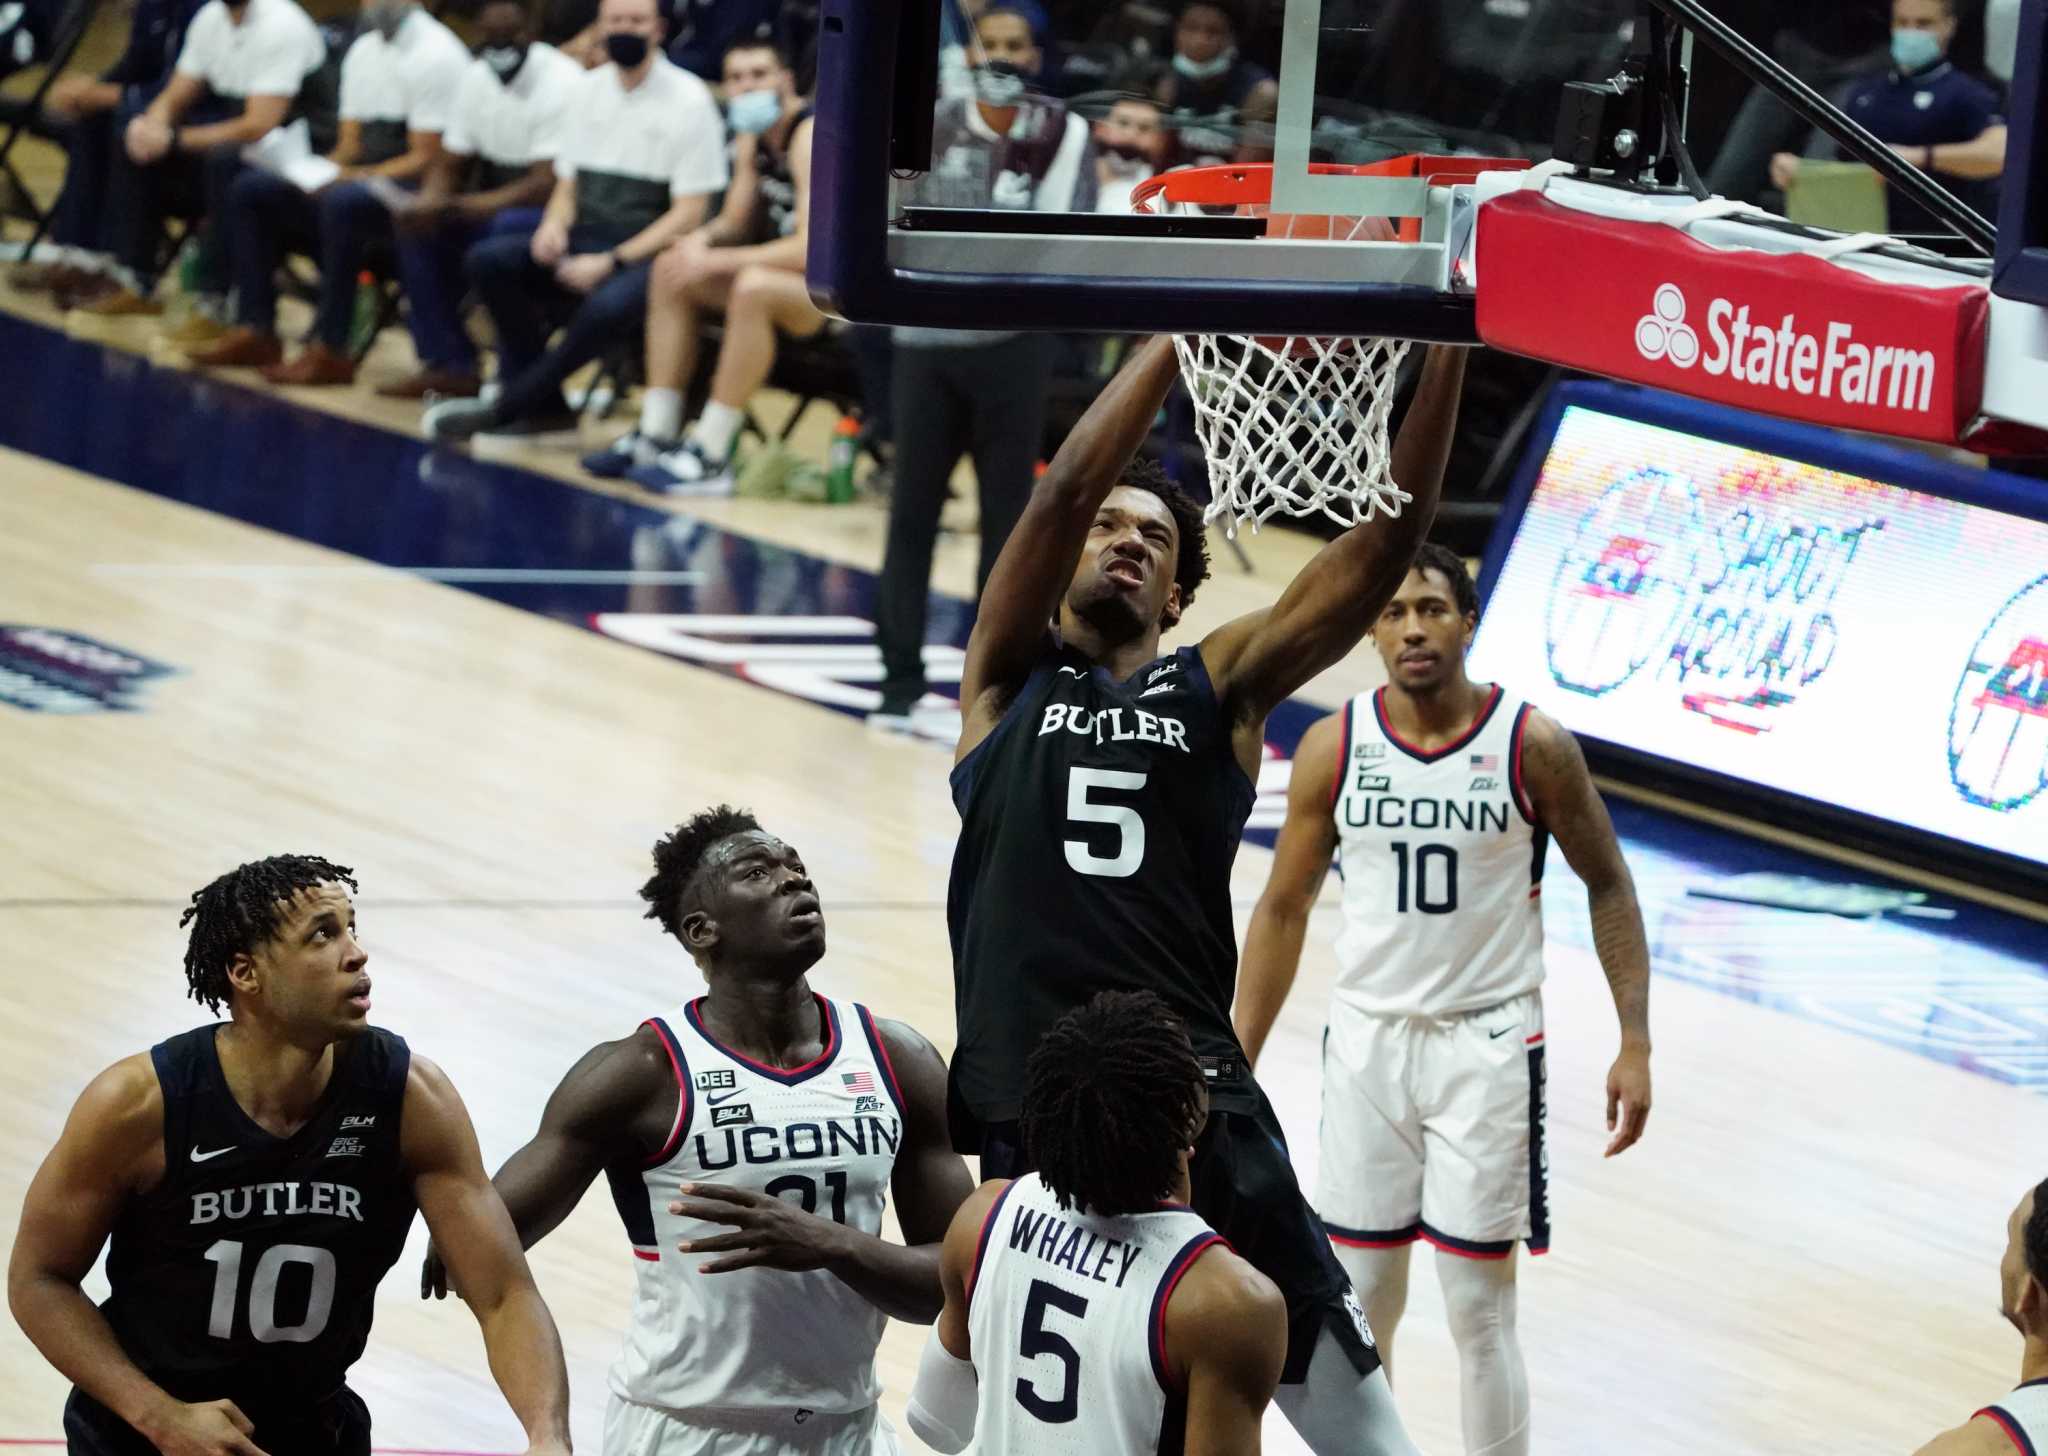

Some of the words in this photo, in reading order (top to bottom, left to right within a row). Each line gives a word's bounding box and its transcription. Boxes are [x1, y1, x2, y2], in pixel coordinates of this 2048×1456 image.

[1038, 703, 1190, 753] BUTLER
[1064, 766, 1147, 877] 5
[1346, 797, 1509, 833] UCONN
[1391, 842, 1458, 914] 10
[697, 1071, 734, 1088] DEE
[716, 1106, 748, 1121] BLM
[855, 1102, 885, 1112] EAST
[856, 1096, 878, 1104] BIG
[332, 1137, 360, 1146] BIG
[341, 1116, 376, 1128] BLM
[328, 1145, 366, 1154] EAST
[695, 1117, 898, 1170] UCONN
[190, 1182, 364, 1225] BUTLER
[1009, 1205, 1142, 1288] WHALEY
[204, 1239, 336, 1343] 10
[1016, 1278, 1089, 1424] 5
